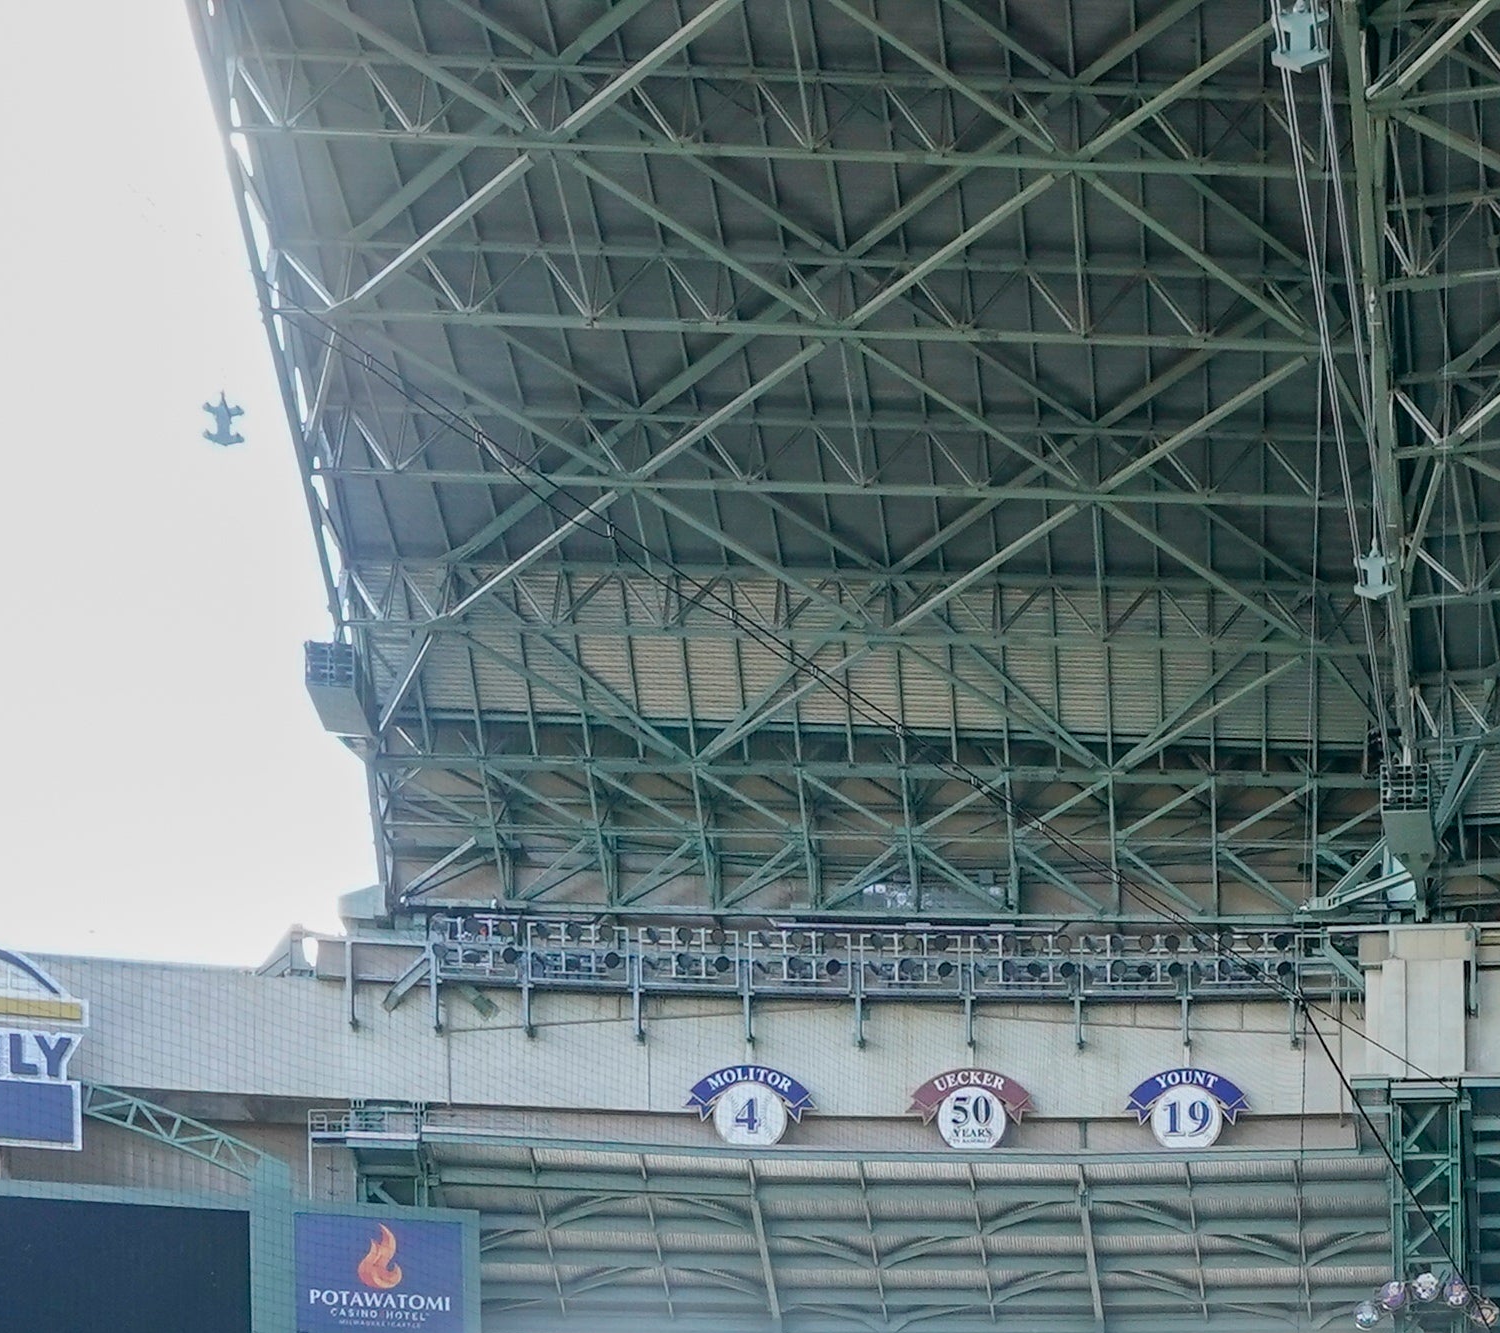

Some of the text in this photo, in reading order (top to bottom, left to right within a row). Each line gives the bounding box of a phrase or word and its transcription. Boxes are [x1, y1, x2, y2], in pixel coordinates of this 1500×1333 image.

[707, 1067, 792, 1093] MOLITOR
[934, 1070, 1005, 1092] UECKER
[1155, 1071, 1218, 1089] YOUNT
[733, 1098, 760, 1134] 4
[951, 1095, 992, 1127] 50
[1165, 1100, 1212, 1136] 19
[310, 1289, 451, 1312] POTAWATOMI
[330, 1308, 425, 1321] CASINO HOTEL
